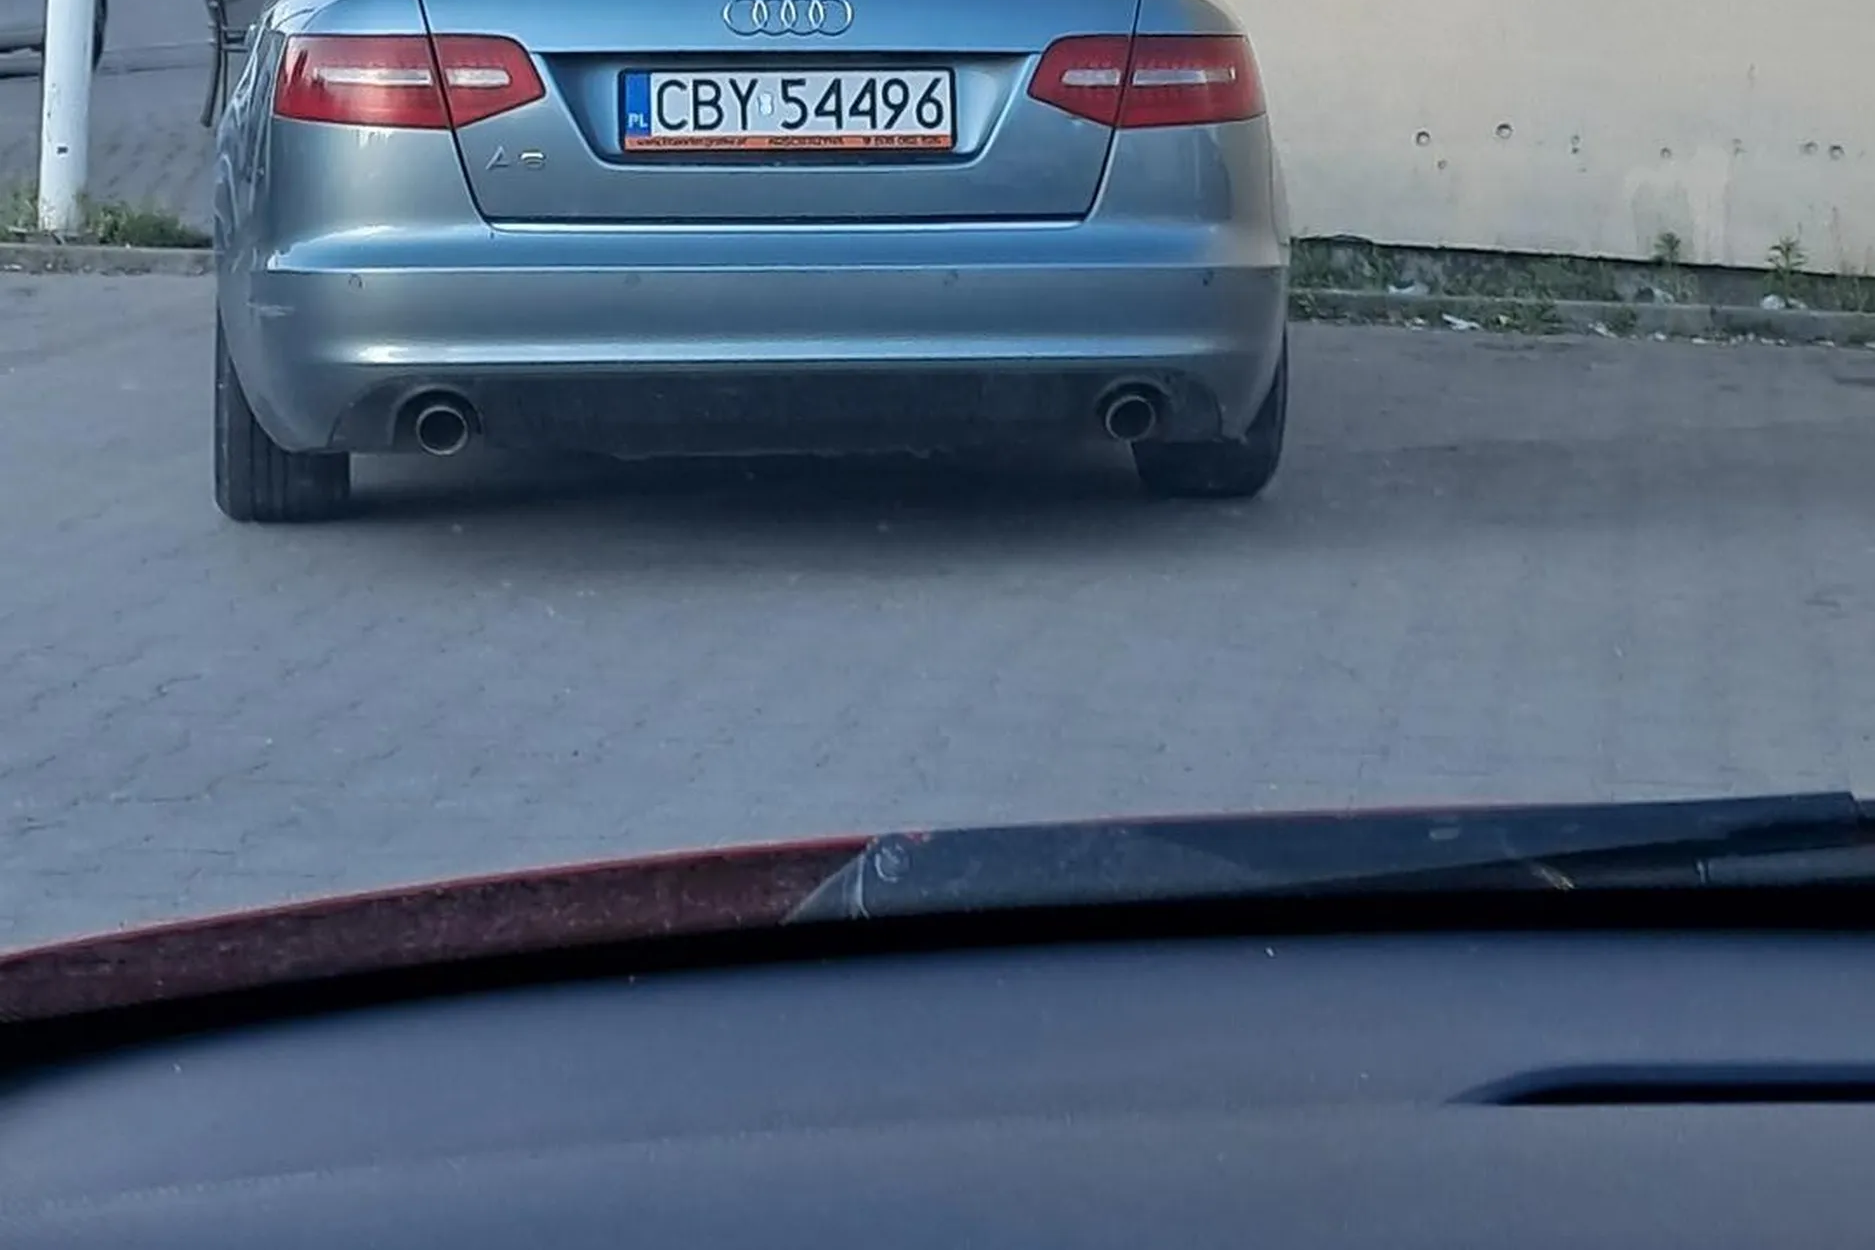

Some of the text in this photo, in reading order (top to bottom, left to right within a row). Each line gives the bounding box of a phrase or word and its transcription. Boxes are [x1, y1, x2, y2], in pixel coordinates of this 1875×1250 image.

[628, 113, 649, 129] PL
[656, 77, 944, 131] CBY 54496
